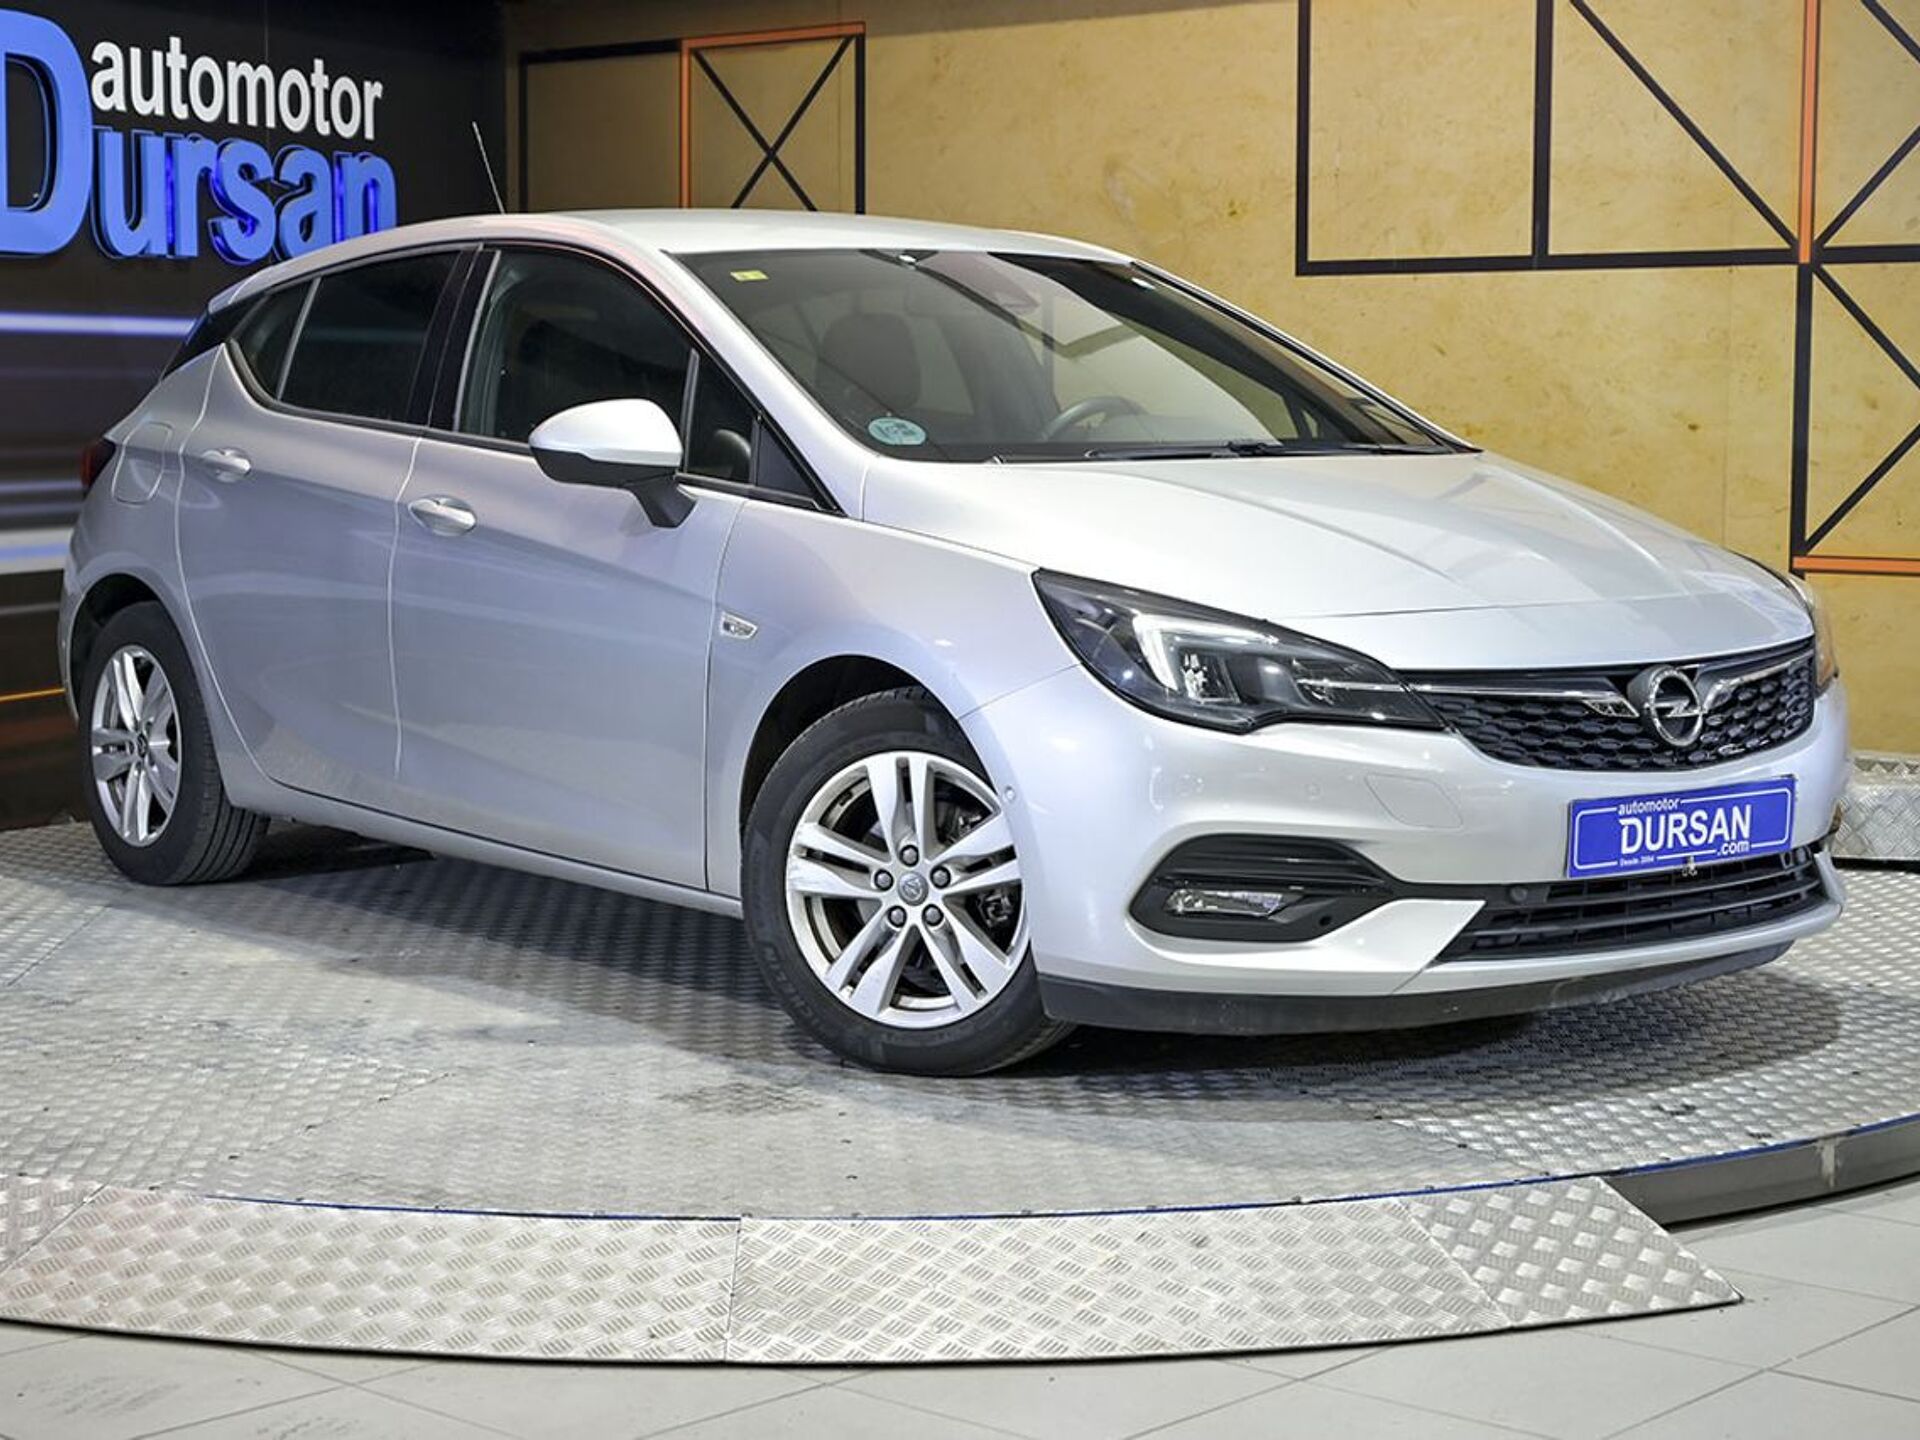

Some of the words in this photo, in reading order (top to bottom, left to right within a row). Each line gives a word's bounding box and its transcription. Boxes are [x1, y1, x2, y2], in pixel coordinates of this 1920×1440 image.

[90, 36, 383, 140] automotor
[0, 8, 398, 265] Dursan
[1618, 797, 1680, 815] automotor
[1618, 804, 1752, 855] DURSAN
[1716, 841, 1750, 857] .com
